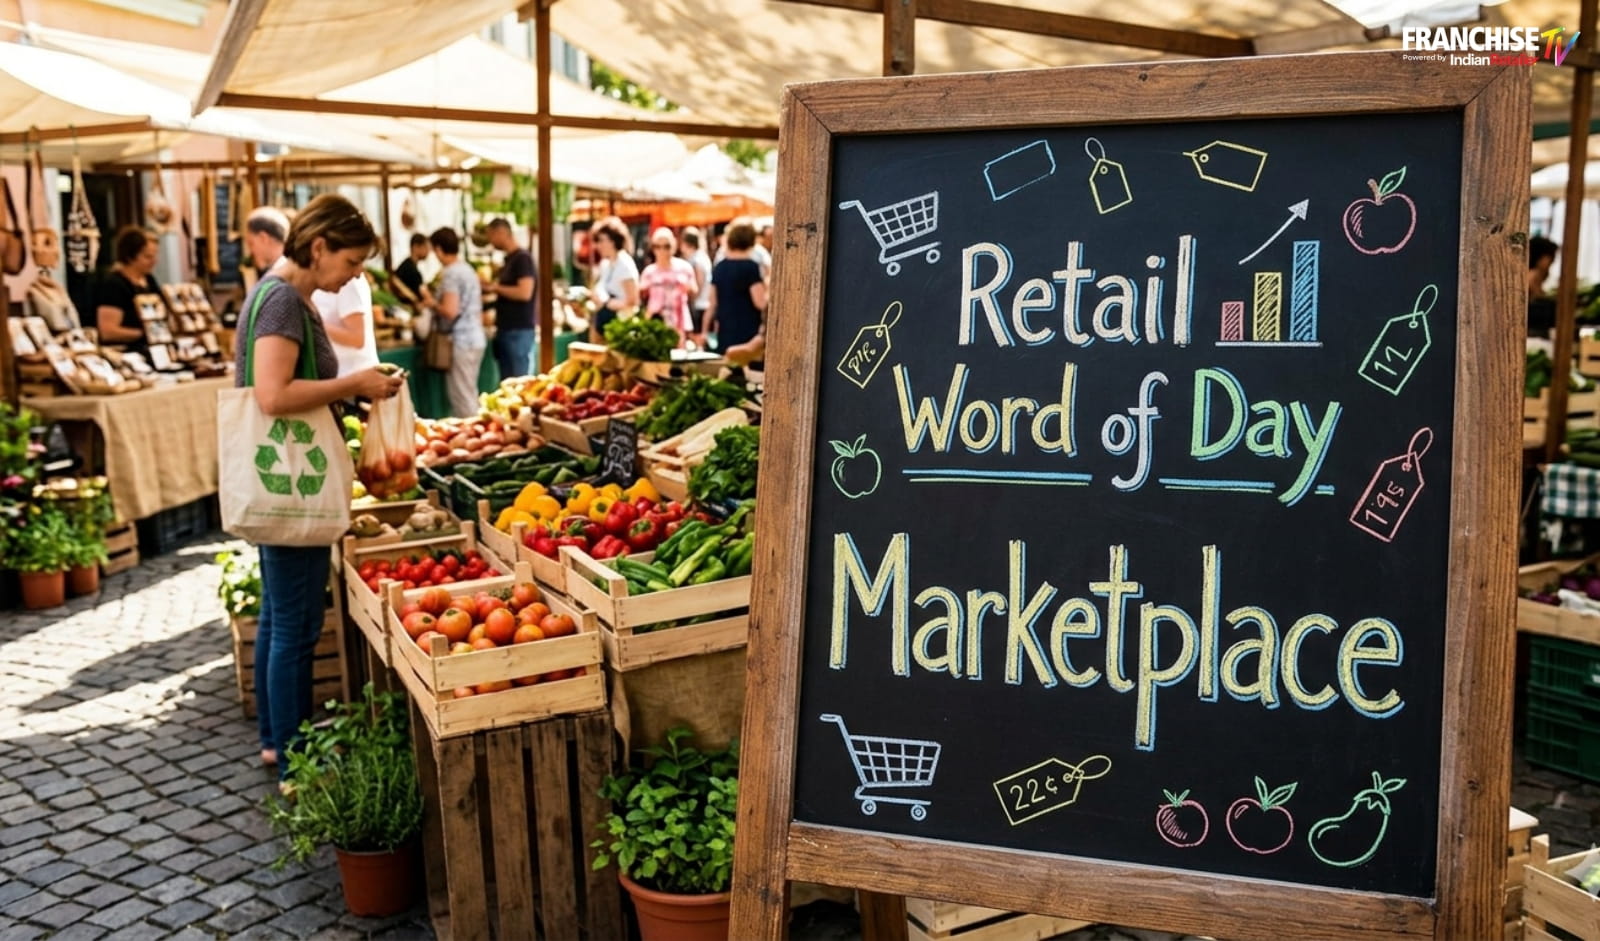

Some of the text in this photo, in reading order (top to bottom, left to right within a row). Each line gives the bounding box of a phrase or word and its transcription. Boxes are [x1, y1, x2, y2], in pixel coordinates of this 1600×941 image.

[958, 234, 1197, 347] Retail
[893, 361, 1342, 507] Word of Day
[828, 532, 1405, 752] Marketplace
